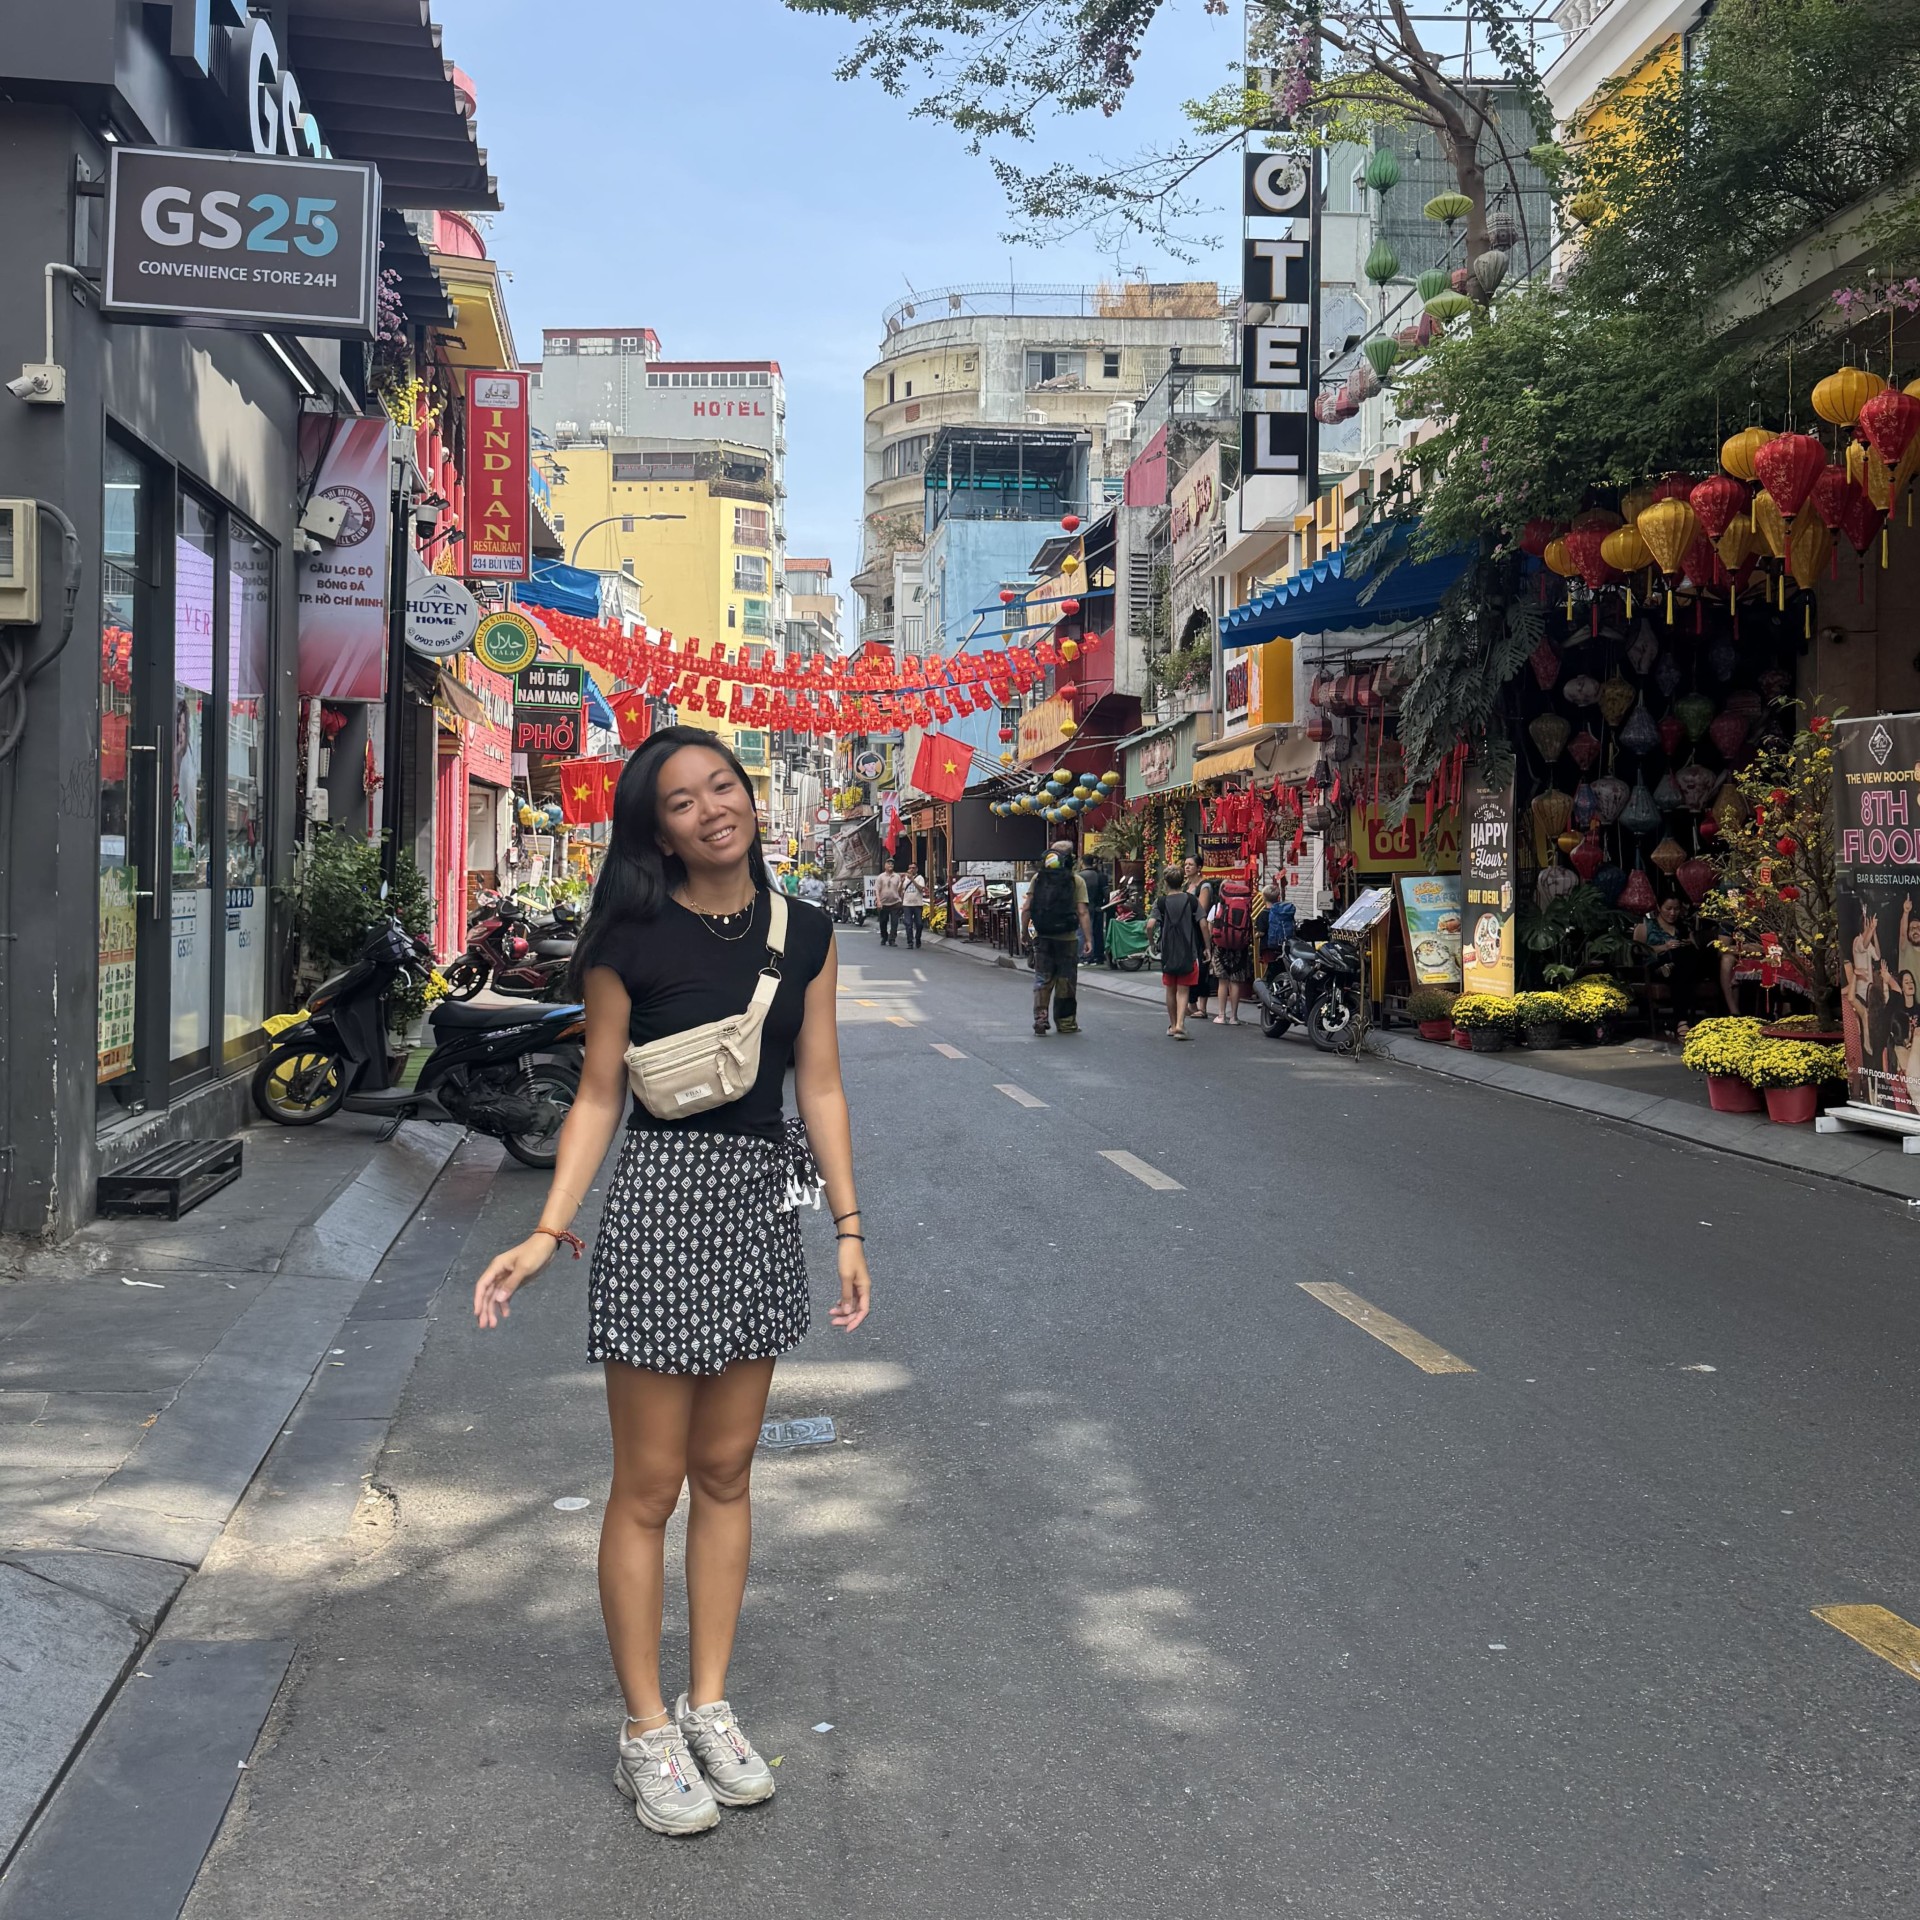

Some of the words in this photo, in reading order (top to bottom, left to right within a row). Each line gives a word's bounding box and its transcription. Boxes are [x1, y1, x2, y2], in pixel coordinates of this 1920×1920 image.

[141, 186, 339, 257] GS25
[138, 260, 248, 281] CONVENIENCE
[252, 269, 301, 285] STORE
[303, 272, 337, 288] 24H
[693, 401, 766, 417] HOTEL
[483, 410, 511, 541] INDIAN
[338, 488, 359, 500] MINH
[357, 496, 371, 513] CITY
[351, 527, 368, 542] CLUB
[473, 541, 521, 553] RESTAURANT
[473, 558, 486, 568] 234
[335, 565, 355, 577] LẠC
[358, 566, 373, 578] BỘ
[317, 578, 347, 590] BÓNG
[350, 580, 365, 591] ĐÁ
[299, 594, 313, 603] TP.
[315, 593, 330, 604] HỒ
[334, 595, 352, 606] CHÍ
[354, 597, 383, 608] MINH
[406, 600, 467, 615] HUYEN
[416, 616, 456, 625] HOME
[414, 634, 433, 646] 0902
[451, 630, 464, 643] 669
[496, 614, 522, 625] INDIAN
[523, 624, 536, 650] CURRY
[529, 668, 545, 685] HỦ
[547, 668, 570, 686] TIẾU
[518, 689, 545, 703] NAM
[547, 691, 579, 705] VANG
[518, 716, 574, 750] PHỞ
[1846, 773, 1861, 784] THE
[1862, 772, 1882, 784] VIEW
[1861, 790, 1908, 826] 8TH
[1202, 837, 1220, 845] THE
[1470, 822, 1509, 849] HAPPY
[1843, 828, 1920, 864] FLOO
[1475, 848, 1503, 870] Hour
[1856, 873, 1868, 883] BAR
[1869, 874, 1874, 884] &
[1468, 889, 1481, 904] HOT
[1482, 890, 1500, 905] DEAL
[1857, 1066, 1868, 1076] 8TH
[1868, 1069, 1886, 1079] FLOOR
